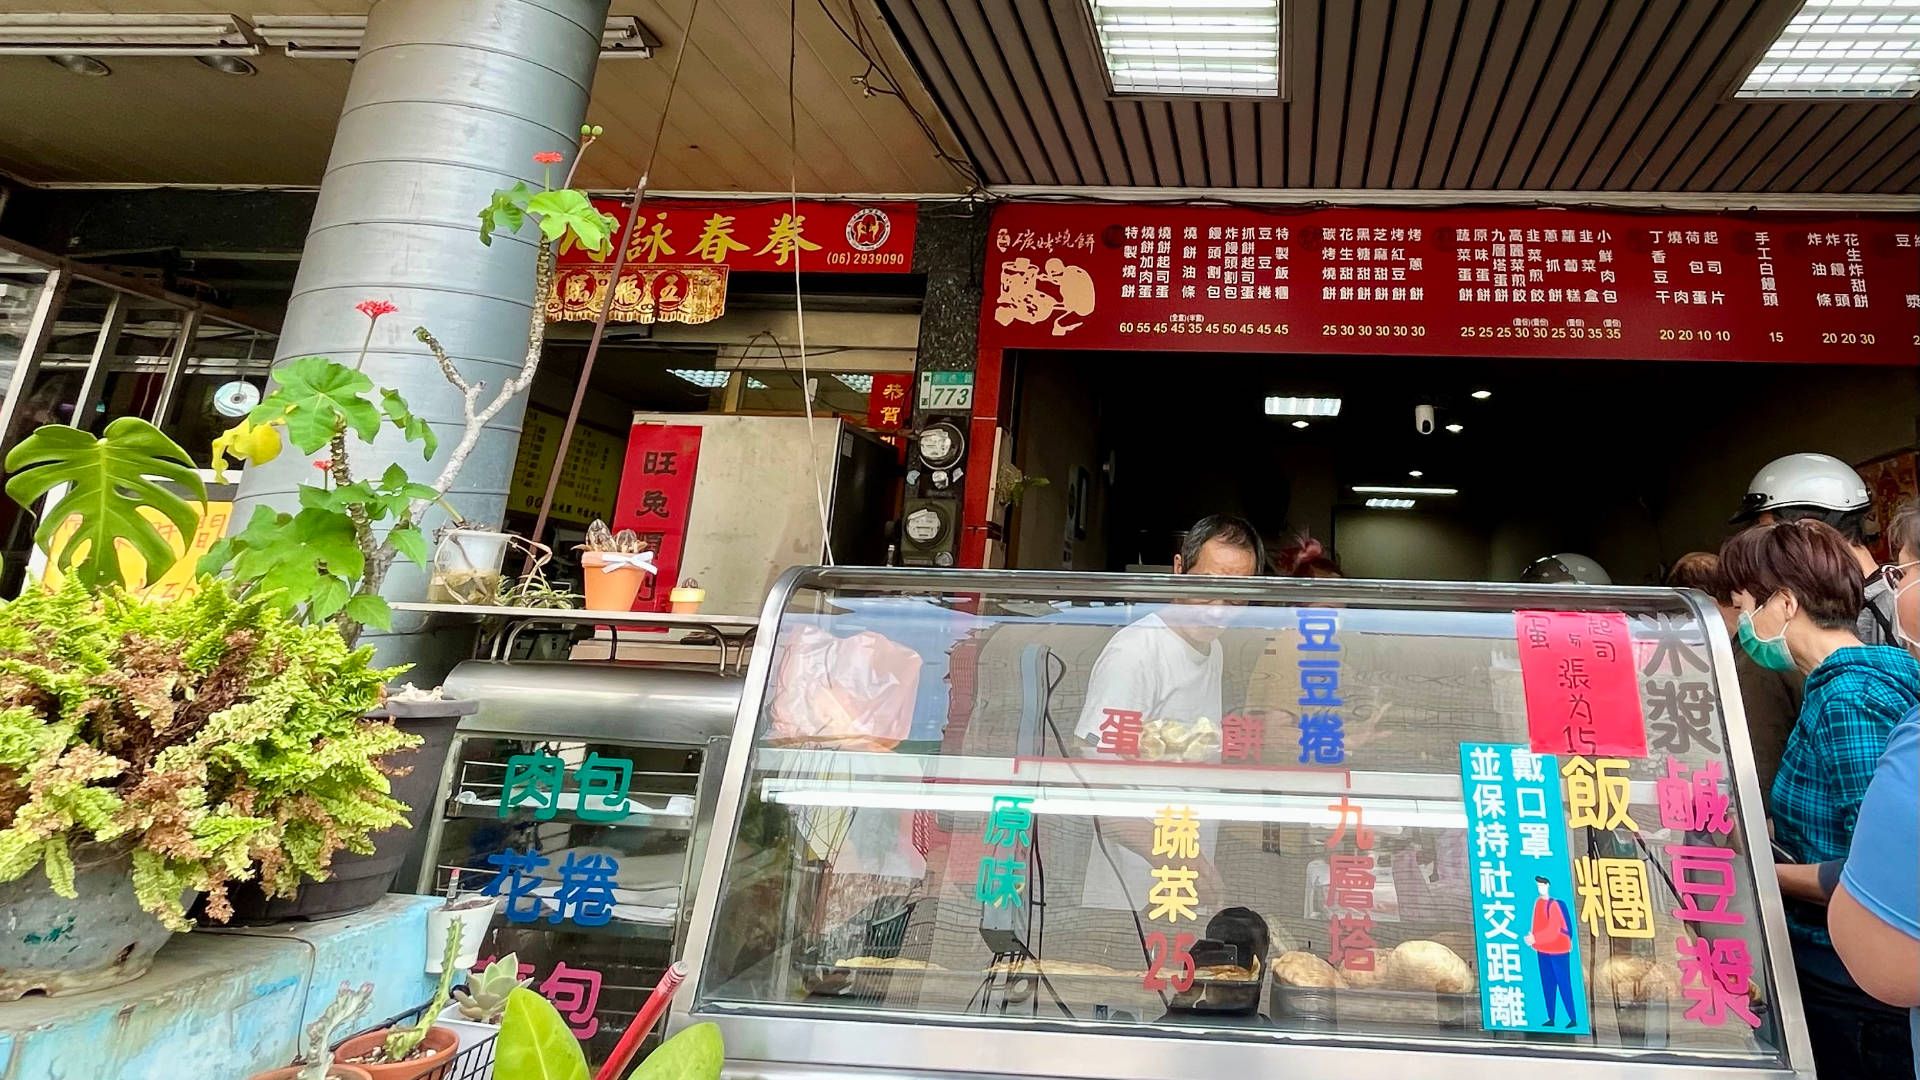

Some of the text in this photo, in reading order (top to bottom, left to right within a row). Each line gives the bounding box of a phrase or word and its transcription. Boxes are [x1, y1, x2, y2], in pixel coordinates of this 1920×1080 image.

[560, 211, 823, 266] 詠春拳
[827, 252, 904, 265] (06) 2939090
[1121, 226, 1138, 298] 特製燒餅
[1138, 226, 1155, 298] 燒餅加肉蛋
[1155, 226, 1171, 298] 燒餅起司蛋
[1182, 227, 1198, 299] 燒餅油條
[1207, 227, 1222, 299] 饅頭割包
[1224, 227, 1239, 299] 炸饅頭割包
[1241, 227, 1256, 299] 抓餅起司蛋
[1257, 227, 1272, 299] 豆豆捲
[1275, 227, 1289, 299] 特製飯糰
[1322, 228, 1336, 301] 碳烤燒餅
[1340, 228, 1354, 301] 花生甜餅
[1356, 228, 1371, 301] 黑糖甜餅
[1373, 228, 1389, 301] 芝麻甜餅
[1391, 228, 1406, 301] 烤紅豆餅
[1456, 229, 1473, 302] 蔬菜蛋餅
[1474, 229, 1491, 302] 原味蛋餅
[1491, 229, 1509, 302] 九層塔蛋餅
[1508, 229, 1527, 302] 高麗菜煎餃
[1527, 229, 1545, 302] 韭菜煎餃
[1579, 230, 1600, 303] 韭菜盒
[1597, 230, 1618, 303] 小鮮肉包
[1648, 231, 1671, 305] 丁香豆干
[1667, 231, 1689, 305] 燒肉
[1685, 231, 1708, 305] 荷包蛋
[1703, 231, 1726, 305] 起司片
[1755, 231, 1779, 307] 手工白饅頭
[1808, 232, 1832, 307] 炸油條
[1825, 233, 1850, 308] 炸饅頭
[1843, 233, 1869, 308] 花生炸甜餅
[1120, 323, 1288, 334] 60 55 45 45 35 45 50 45 45 45
[1323, 325, 1425, 336] 25 30 30 30 30 30
[1461, 326, 1621, 339] 25 25 25 30 30 25 30 35 35
[1660, 330, 1730, 341] 20 20 10 10
[1770, 332, 1783, 342] 15
[1823, 333, 1874, 344] 20 20 30
[1913, 335, 1920, 346] 2
[880, 384, 904, 445] 恭賀
[933, 388, 969, 406] 773
[1296, 607, 1345, 764] 豆豆捲
[1635, 612, 1721, 754] 米漿
[498, 749, 634, 823] 肉包
[1510, 749, 1554, 860] 戴口罩
[975, 795, 1036, 908] 原味
[1147, 804, 1201, 924] 蔬菜
[1327, 793, 1378, 972] 九層塔
[1561, 754, 1656, 938] 飯糰
[482, 847, 619, 927] 花捲
[1469, 746, 1528, 1028] 並保持社交距離
[1656, 754, 1762, 1028] 鹹豆漿
[472, 954, 603, 1040] 包
[1142, 932, 1196, 993] 25
